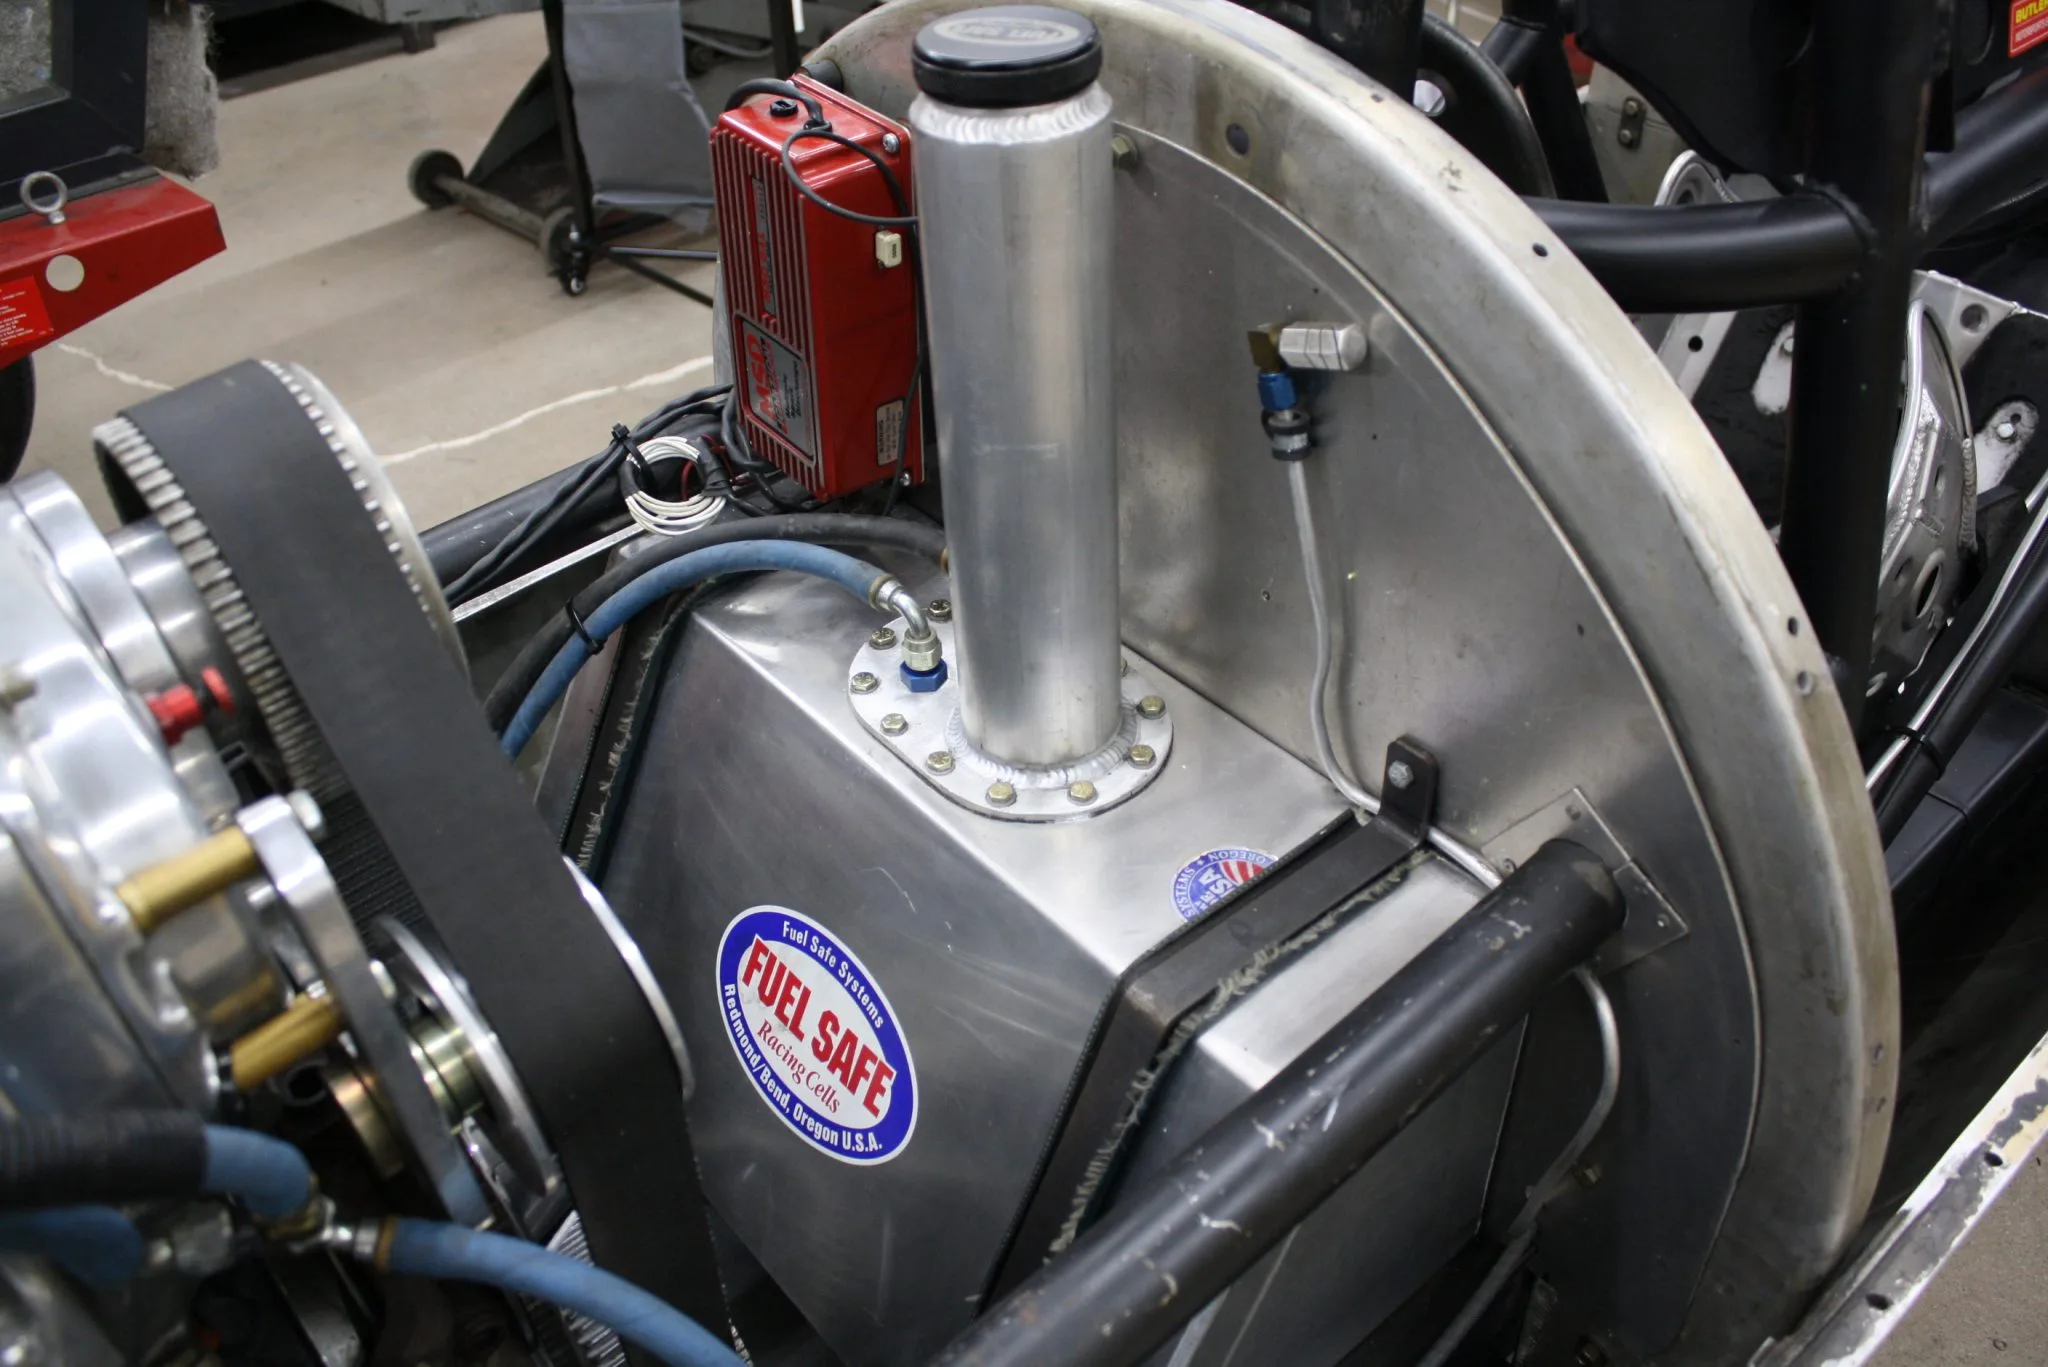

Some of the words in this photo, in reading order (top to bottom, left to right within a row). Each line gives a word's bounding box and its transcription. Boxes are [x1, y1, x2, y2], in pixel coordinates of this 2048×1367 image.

[1175, 867, 1196, 917] SYSTEMS
[1208, 850, 1266, 863] OREGON
[783, 921, 808, 947] Fuel
[810, 935, 836, 968] Safe
[838, 961, 884, 1028] Systems
[724, 983, 790, 1114] Redmond/Bend,
[793, 1102, 839, 1147] Oregon
[842, 1130, 883, 1152] U.S.A.
[742, 937, 812, 1042] FUEL
[811, 1010, 895, 1118] SAFE
[757, 1019, 805, 1084] Racing
[806, 1071, 841, 1114] Cells
